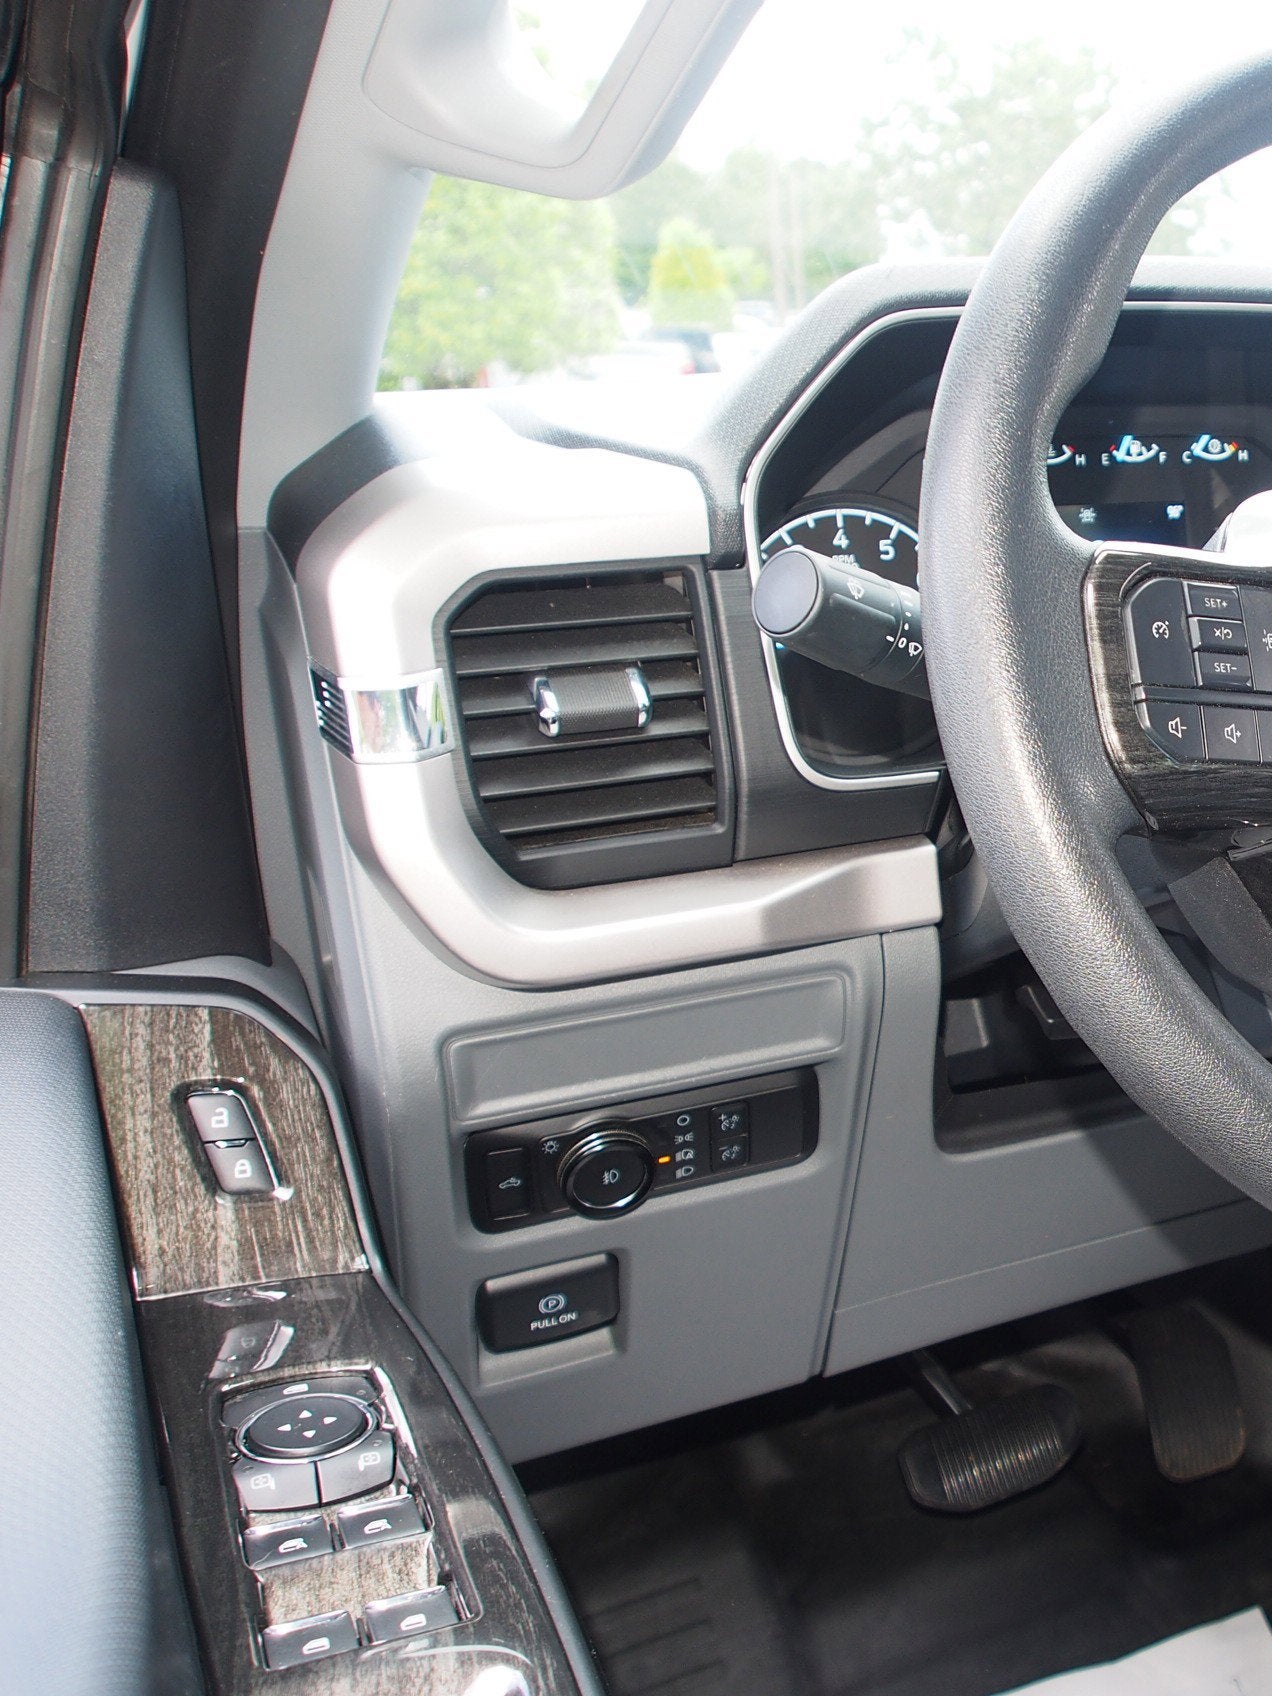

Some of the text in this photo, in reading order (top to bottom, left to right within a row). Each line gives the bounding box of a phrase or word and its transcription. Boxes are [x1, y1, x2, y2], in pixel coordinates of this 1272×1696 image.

[1075, 453, 1086, 466] H
[1101, 453, 1110, 465] E
[1159, 452, 1168, 464] F
[1182, 451, 1192, 464] C
[1237, 450, 1249, 462] H
[832, 529, 850, 549] 4
[878, 539, 896, 561] 5
[1204, 598, 1228, 609] SET+
[530, 1312, 577, 1331] PULL ON
